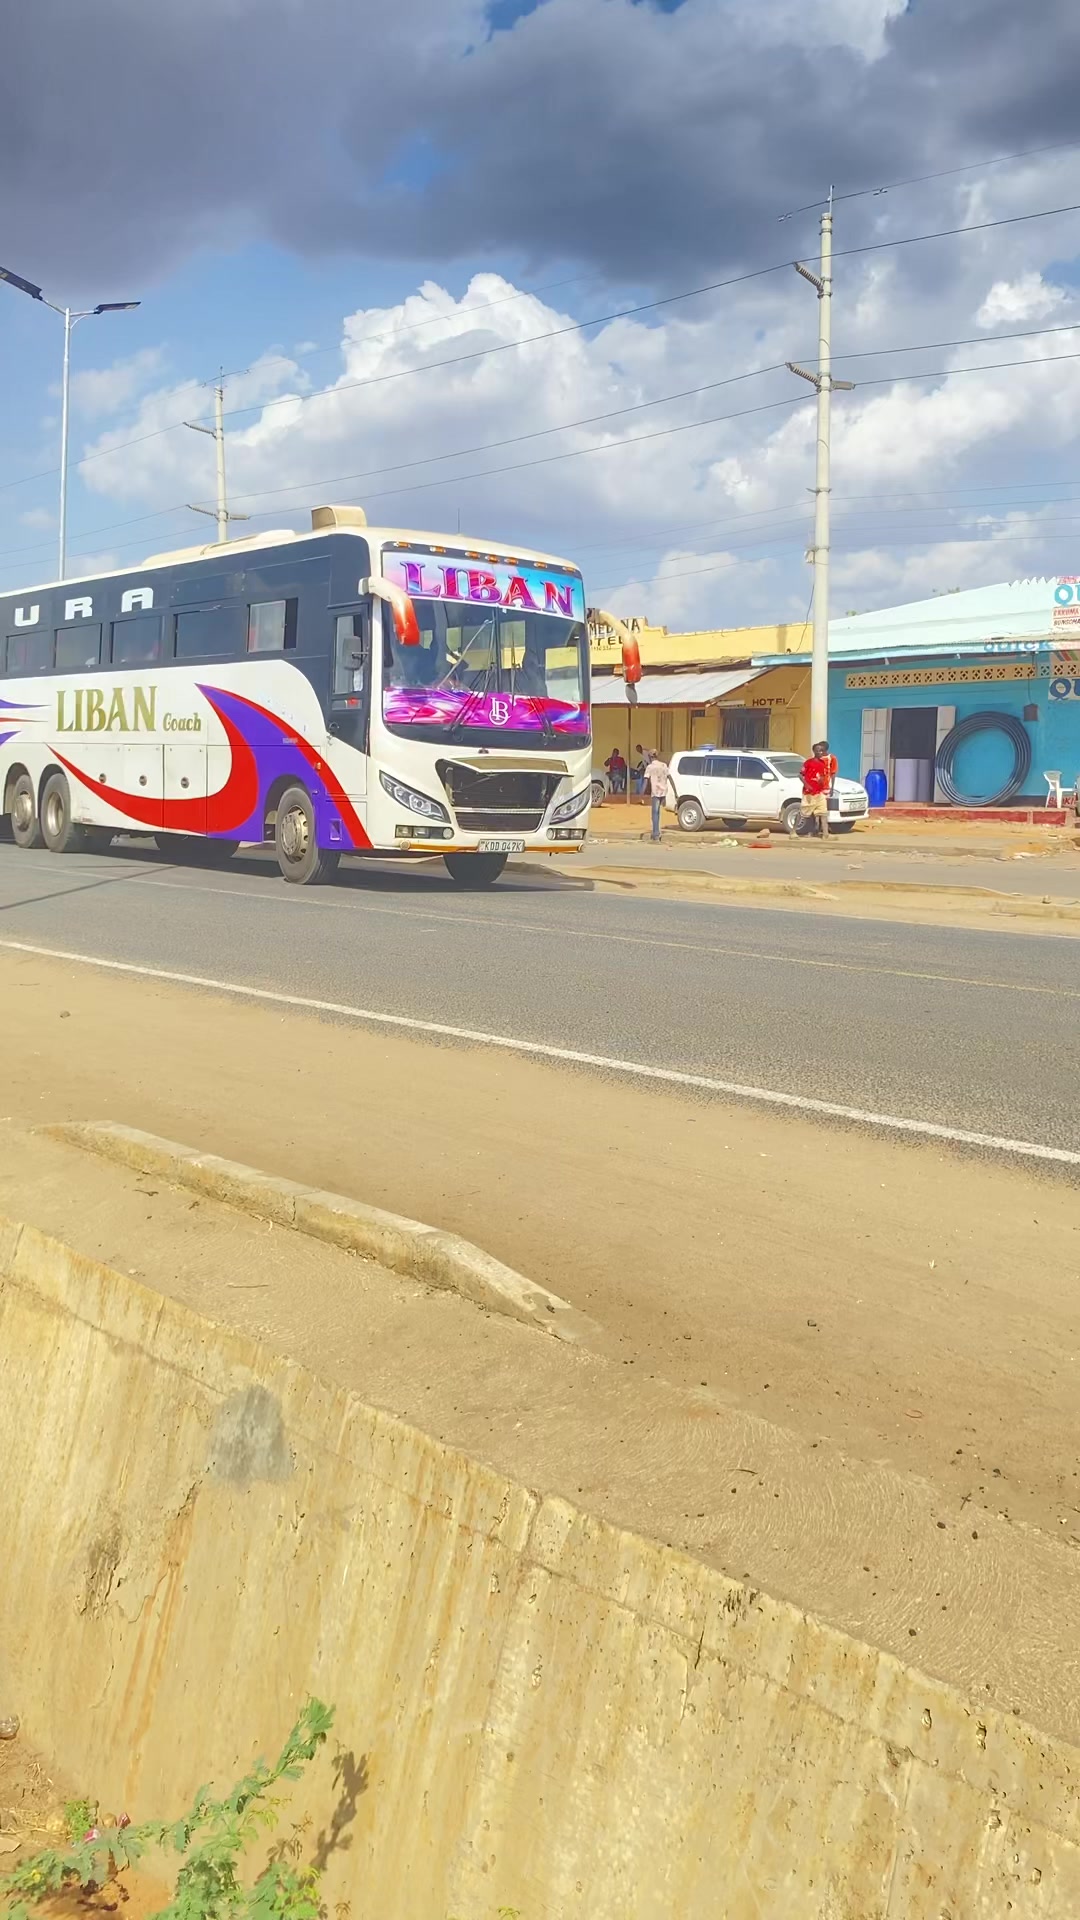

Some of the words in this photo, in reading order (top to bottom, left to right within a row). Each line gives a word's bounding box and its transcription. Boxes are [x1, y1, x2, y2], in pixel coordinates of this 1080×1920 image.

[400, 561, 575, 617] LIBAN
[56, 686, 158, 732] LIBAN
[752, 698, 788, 707] HOTEL
[162, 712, 202, 732] Coach
